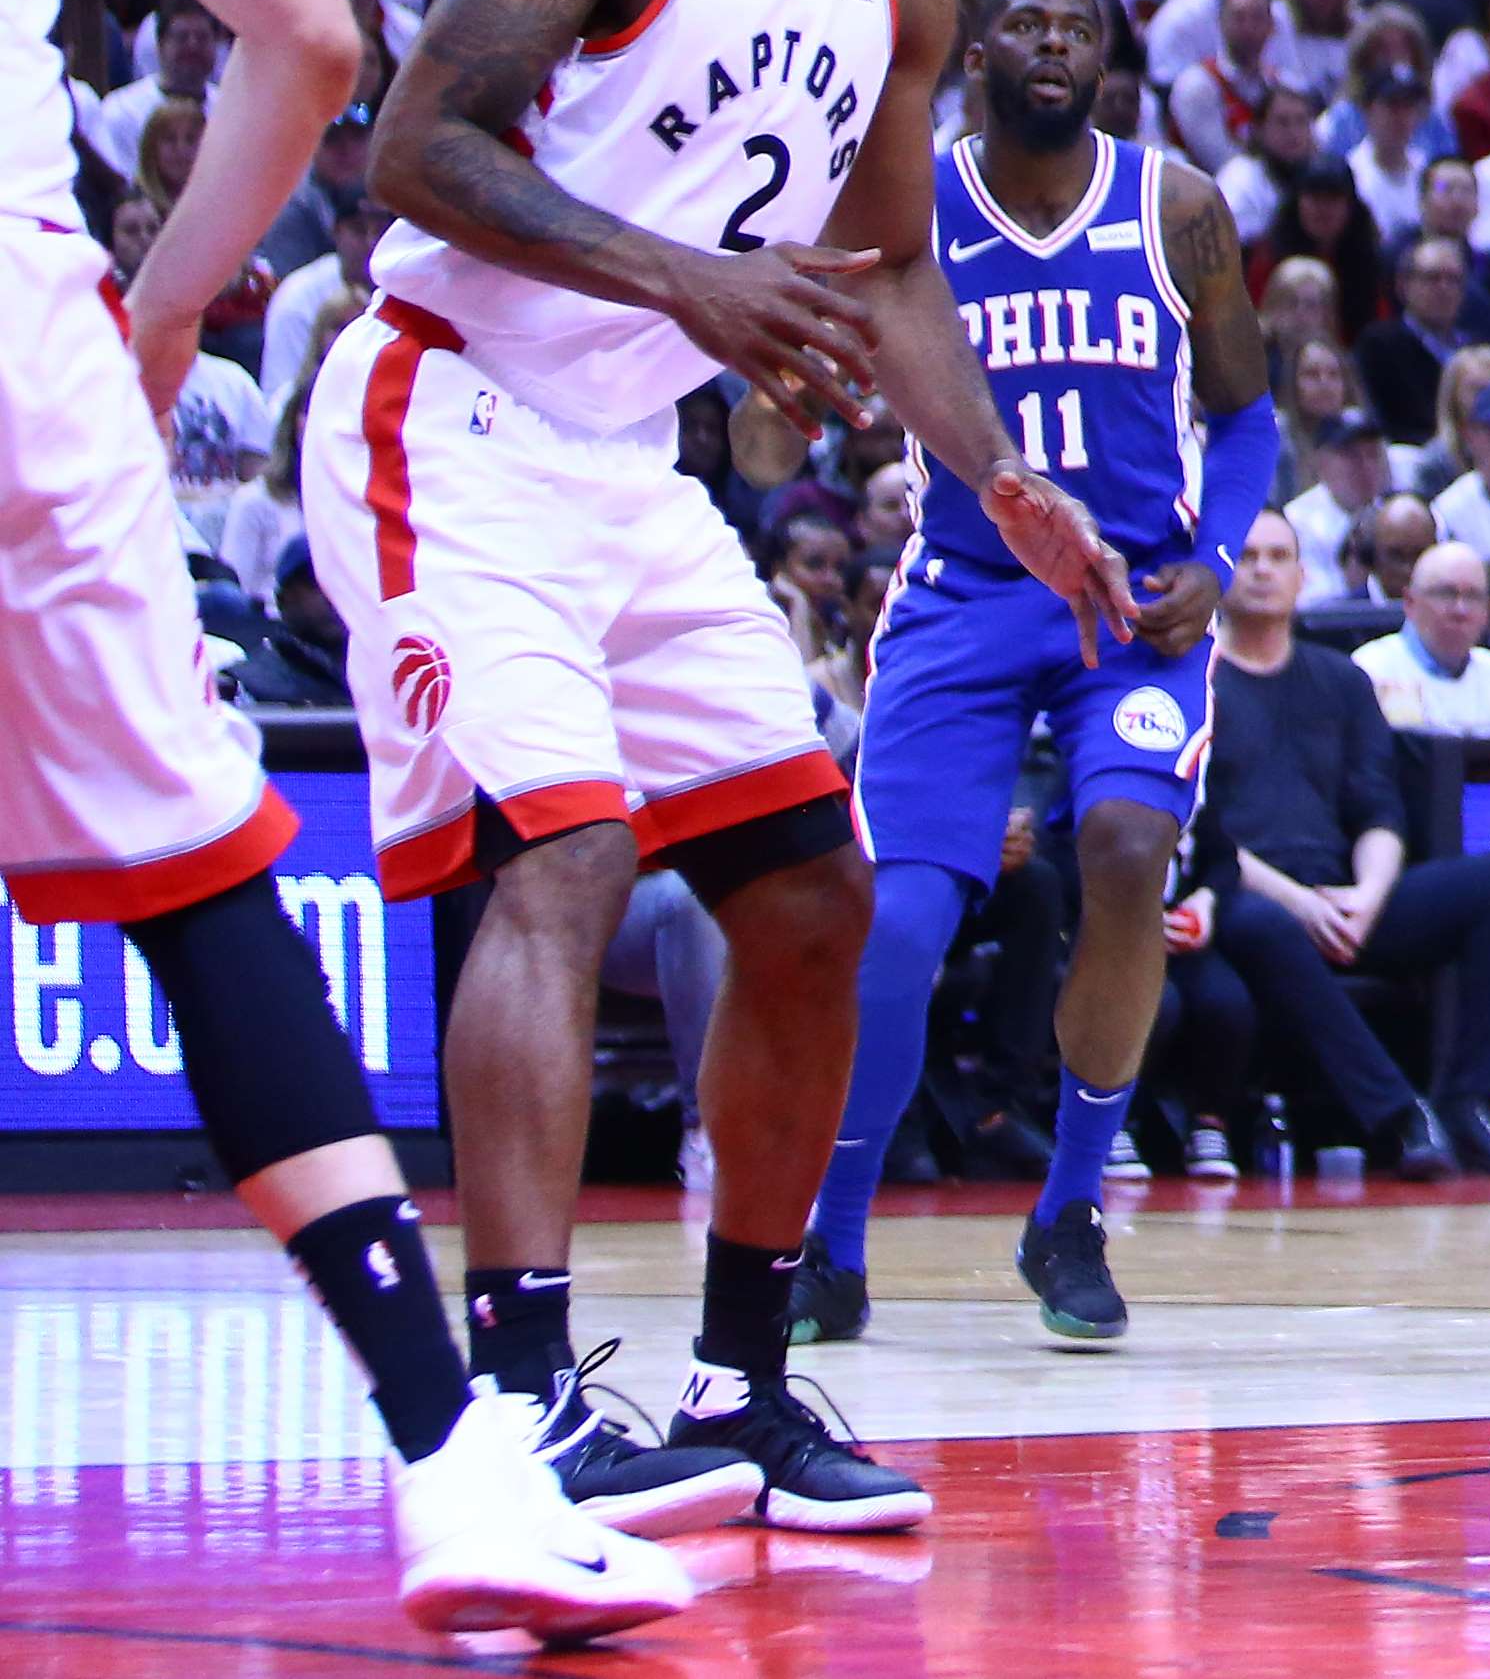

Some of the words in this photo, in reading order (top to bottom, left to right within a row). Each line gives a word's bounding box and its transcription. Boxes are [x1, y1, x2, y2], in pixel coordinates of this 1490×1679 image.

[648, 29, 859, 182] RAPTORS
[718, 134, 791, 253] 2
[1017, 389, 1090, 471] 11
